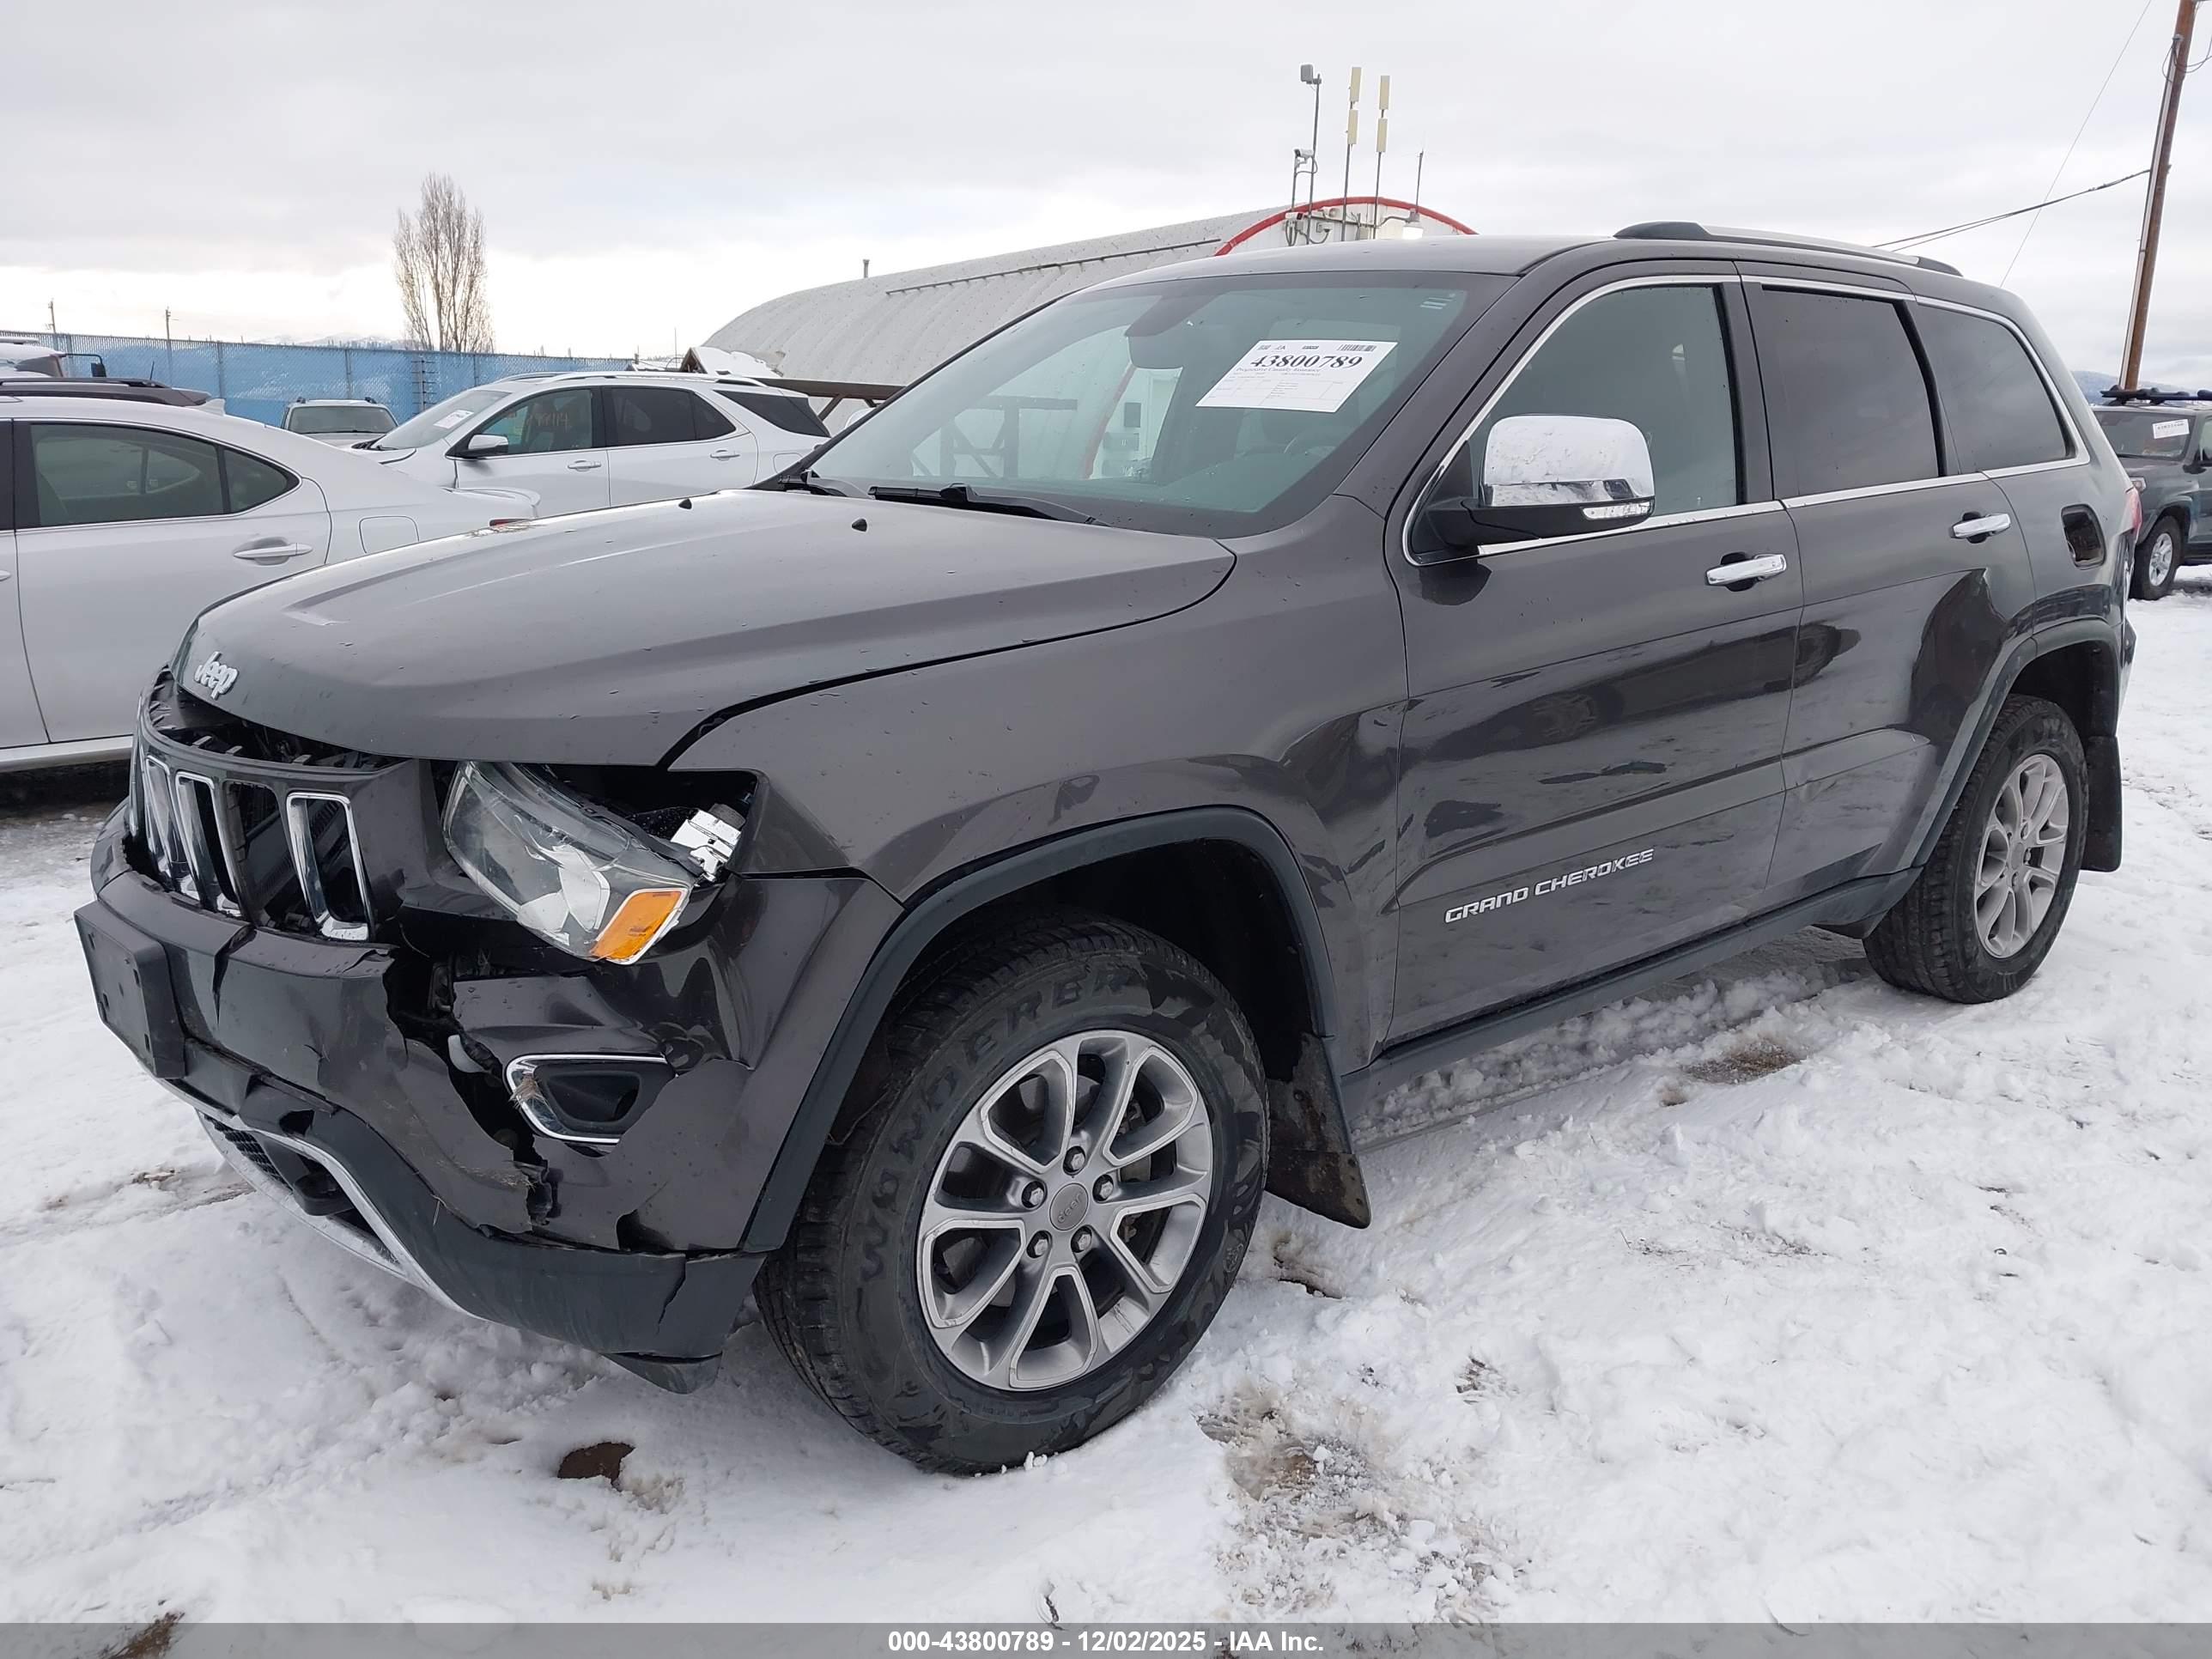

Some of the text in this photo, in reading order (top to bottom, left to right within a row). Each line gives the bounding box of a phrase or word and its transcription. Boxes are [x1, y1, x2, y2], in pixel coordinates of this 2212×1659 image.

[1250, 355, 1363, 368] 43800789
[194, 651, 239, 699] Jeep
[1444, 848, 1655, 923] GRAND CHEROKEE
